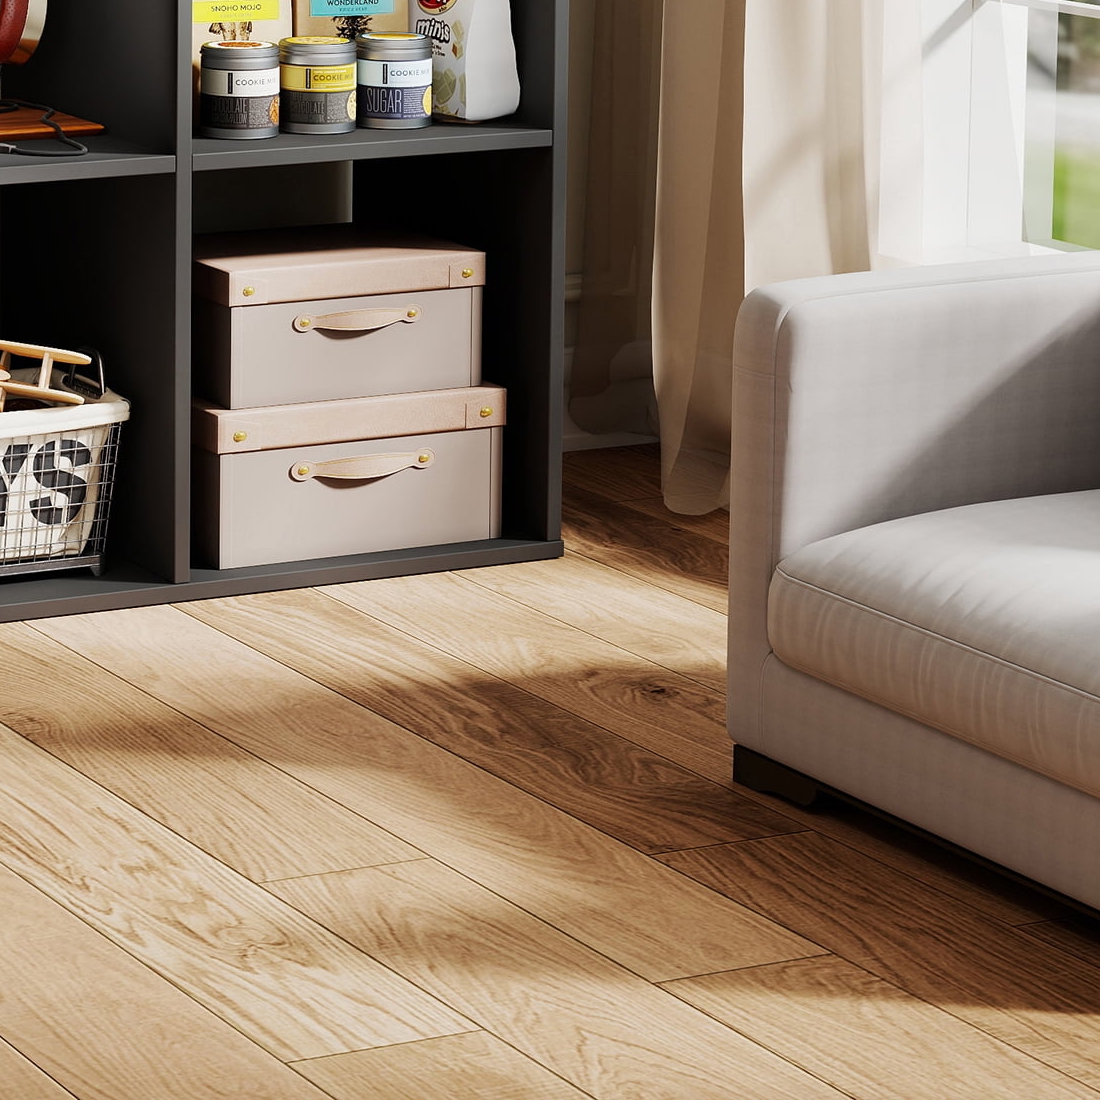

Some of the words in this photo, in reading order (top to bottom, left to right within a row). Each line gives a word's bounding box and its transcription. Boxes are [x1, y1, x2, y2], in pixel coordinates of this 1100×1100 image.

[240, 3, 262, 11] MOJO
[416, 17, 451, 44] minis
[390, 69, 419, 77] COOKIE
[235, 78, 265, 86] COOKIE
[366, 87, 402, 113] SUGAR
